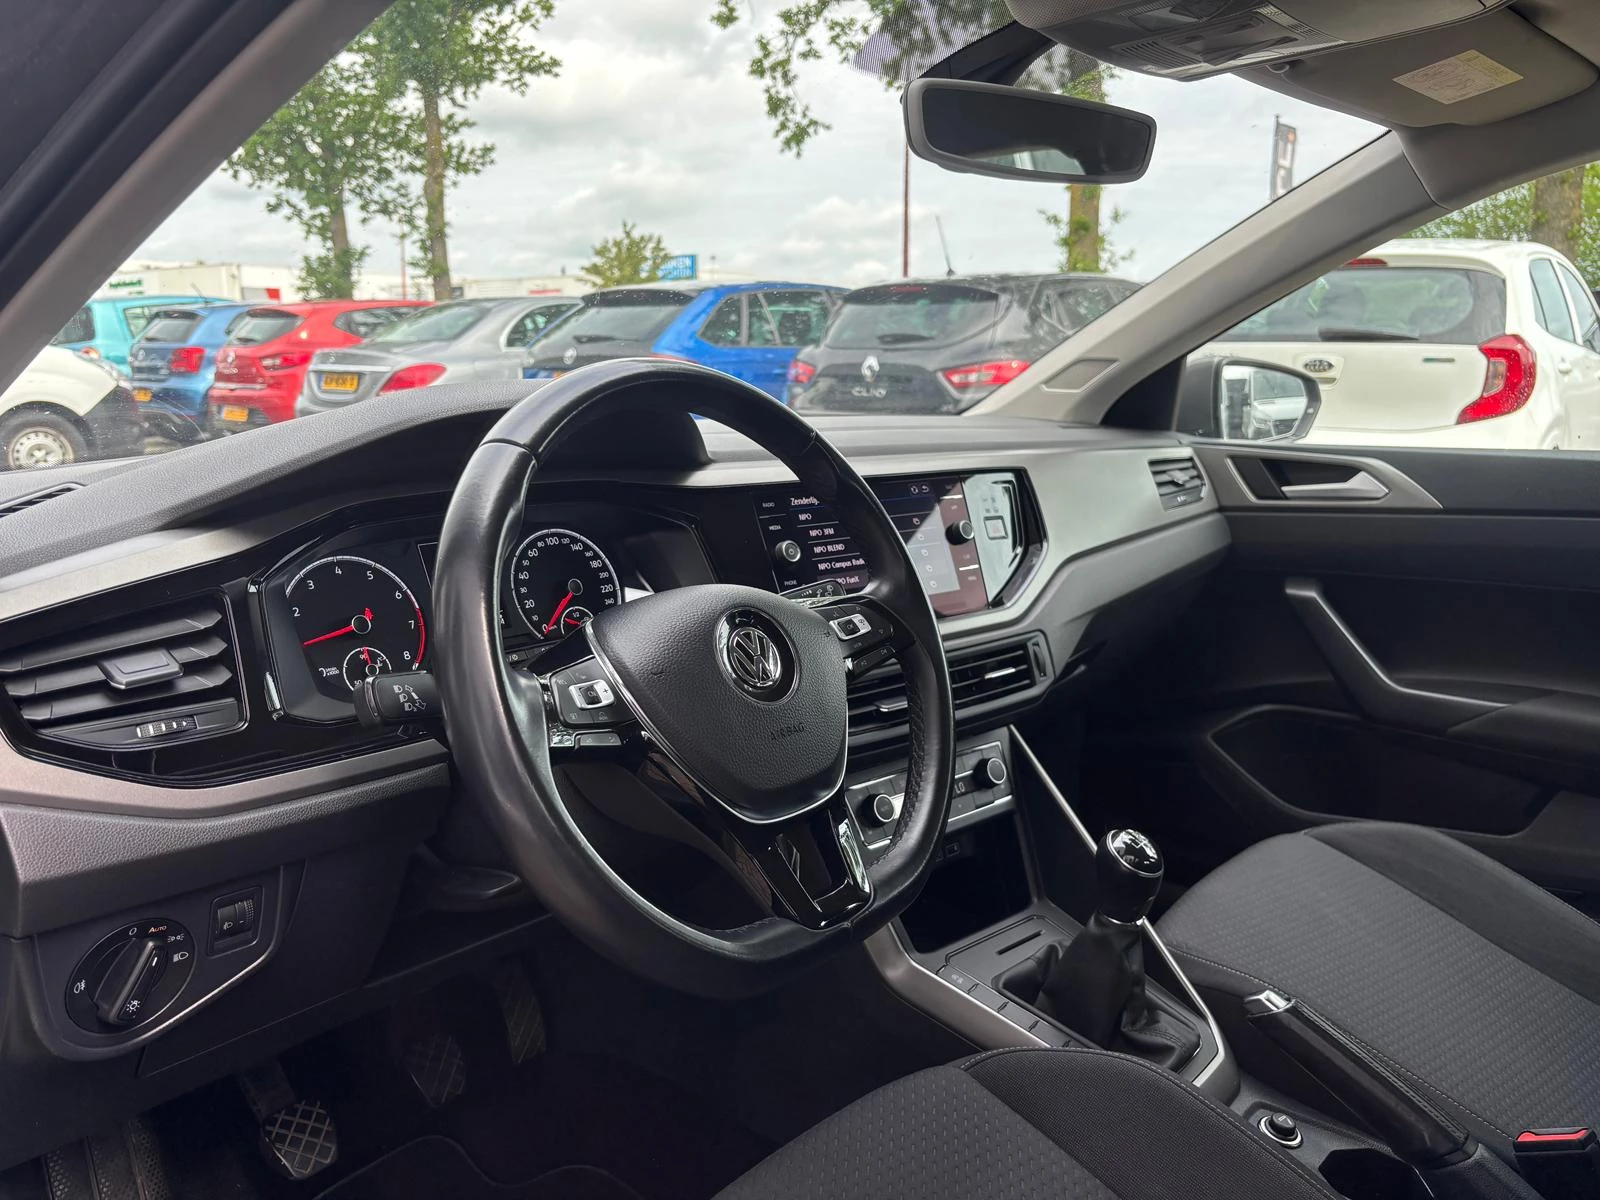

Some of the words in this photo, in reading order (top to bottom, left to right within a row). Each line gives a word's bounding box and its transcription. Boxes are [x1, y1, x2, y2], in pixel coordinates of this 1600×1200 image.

[809, 529, 822, 537] NPO
[823, 528, 834, 536] 3FM
[545, 536, 559, 546] 100
[570, 542, 584, 552] 140
[814, 545, 827, 554] NPO
[827, 543, 845, 552] BLEND
[528, 548, 538, 557] 60
[589, 559, 602, 568] 180
[818, 562, 831, 570] NPO
[832, 560, 852, 569] Campus
[335, 566, 342, 575] 4
[366, 570, 374, 580] 5
[519, 571, 529, 580] 40
[306, 580, 315, 590] 3
[600, 584, 613, 593] 220
[395, 590, 402, 599] 6
[524, 600, 535, 609] 20
[292, 607, 301, 617] 2
[408, 620, 415, 630] 7
[403, 651, 411, 660] 8
